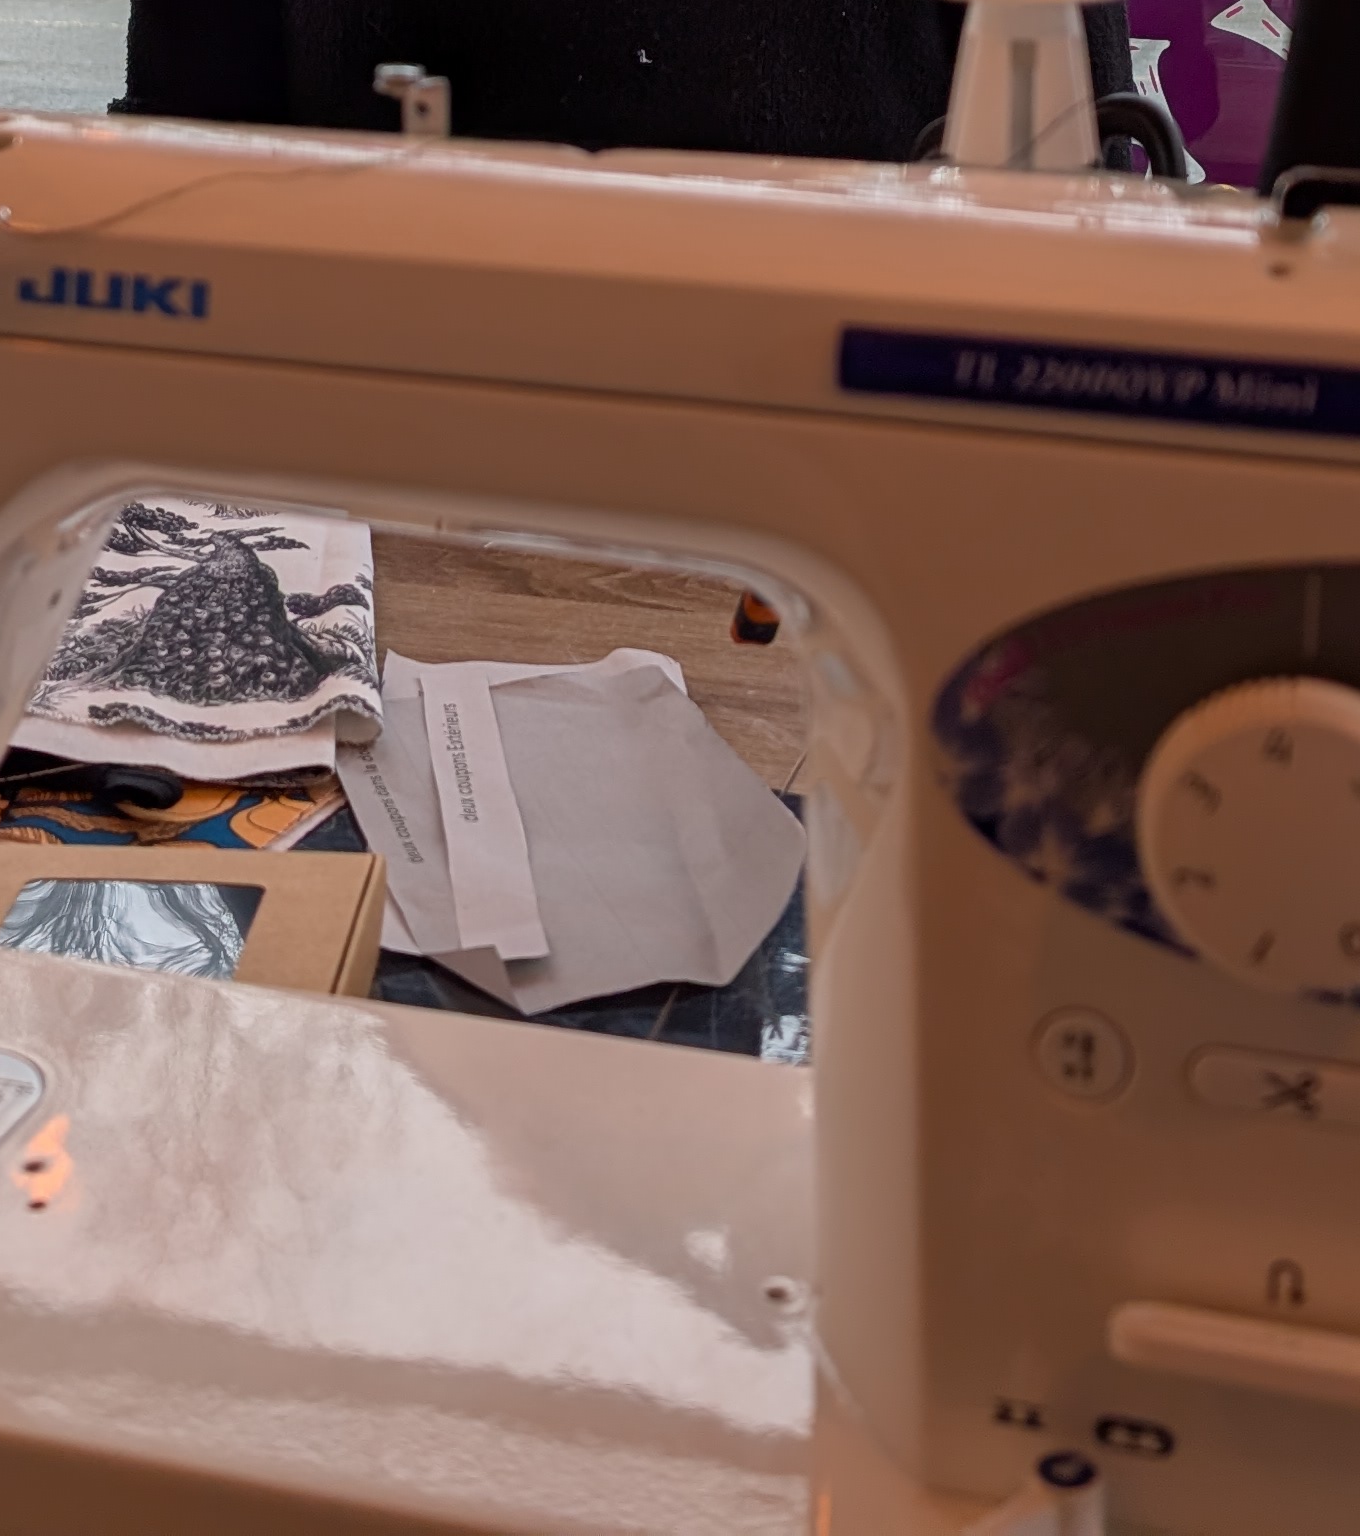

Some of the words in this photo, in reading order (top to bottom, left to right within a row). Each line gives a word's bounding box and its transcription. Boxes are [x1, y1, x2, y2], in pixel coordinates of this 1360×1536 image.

[18, 268, 211, 321] JUKI
[451, 751, 474, 797] coupons
[459, 796, 480, 824] deux
